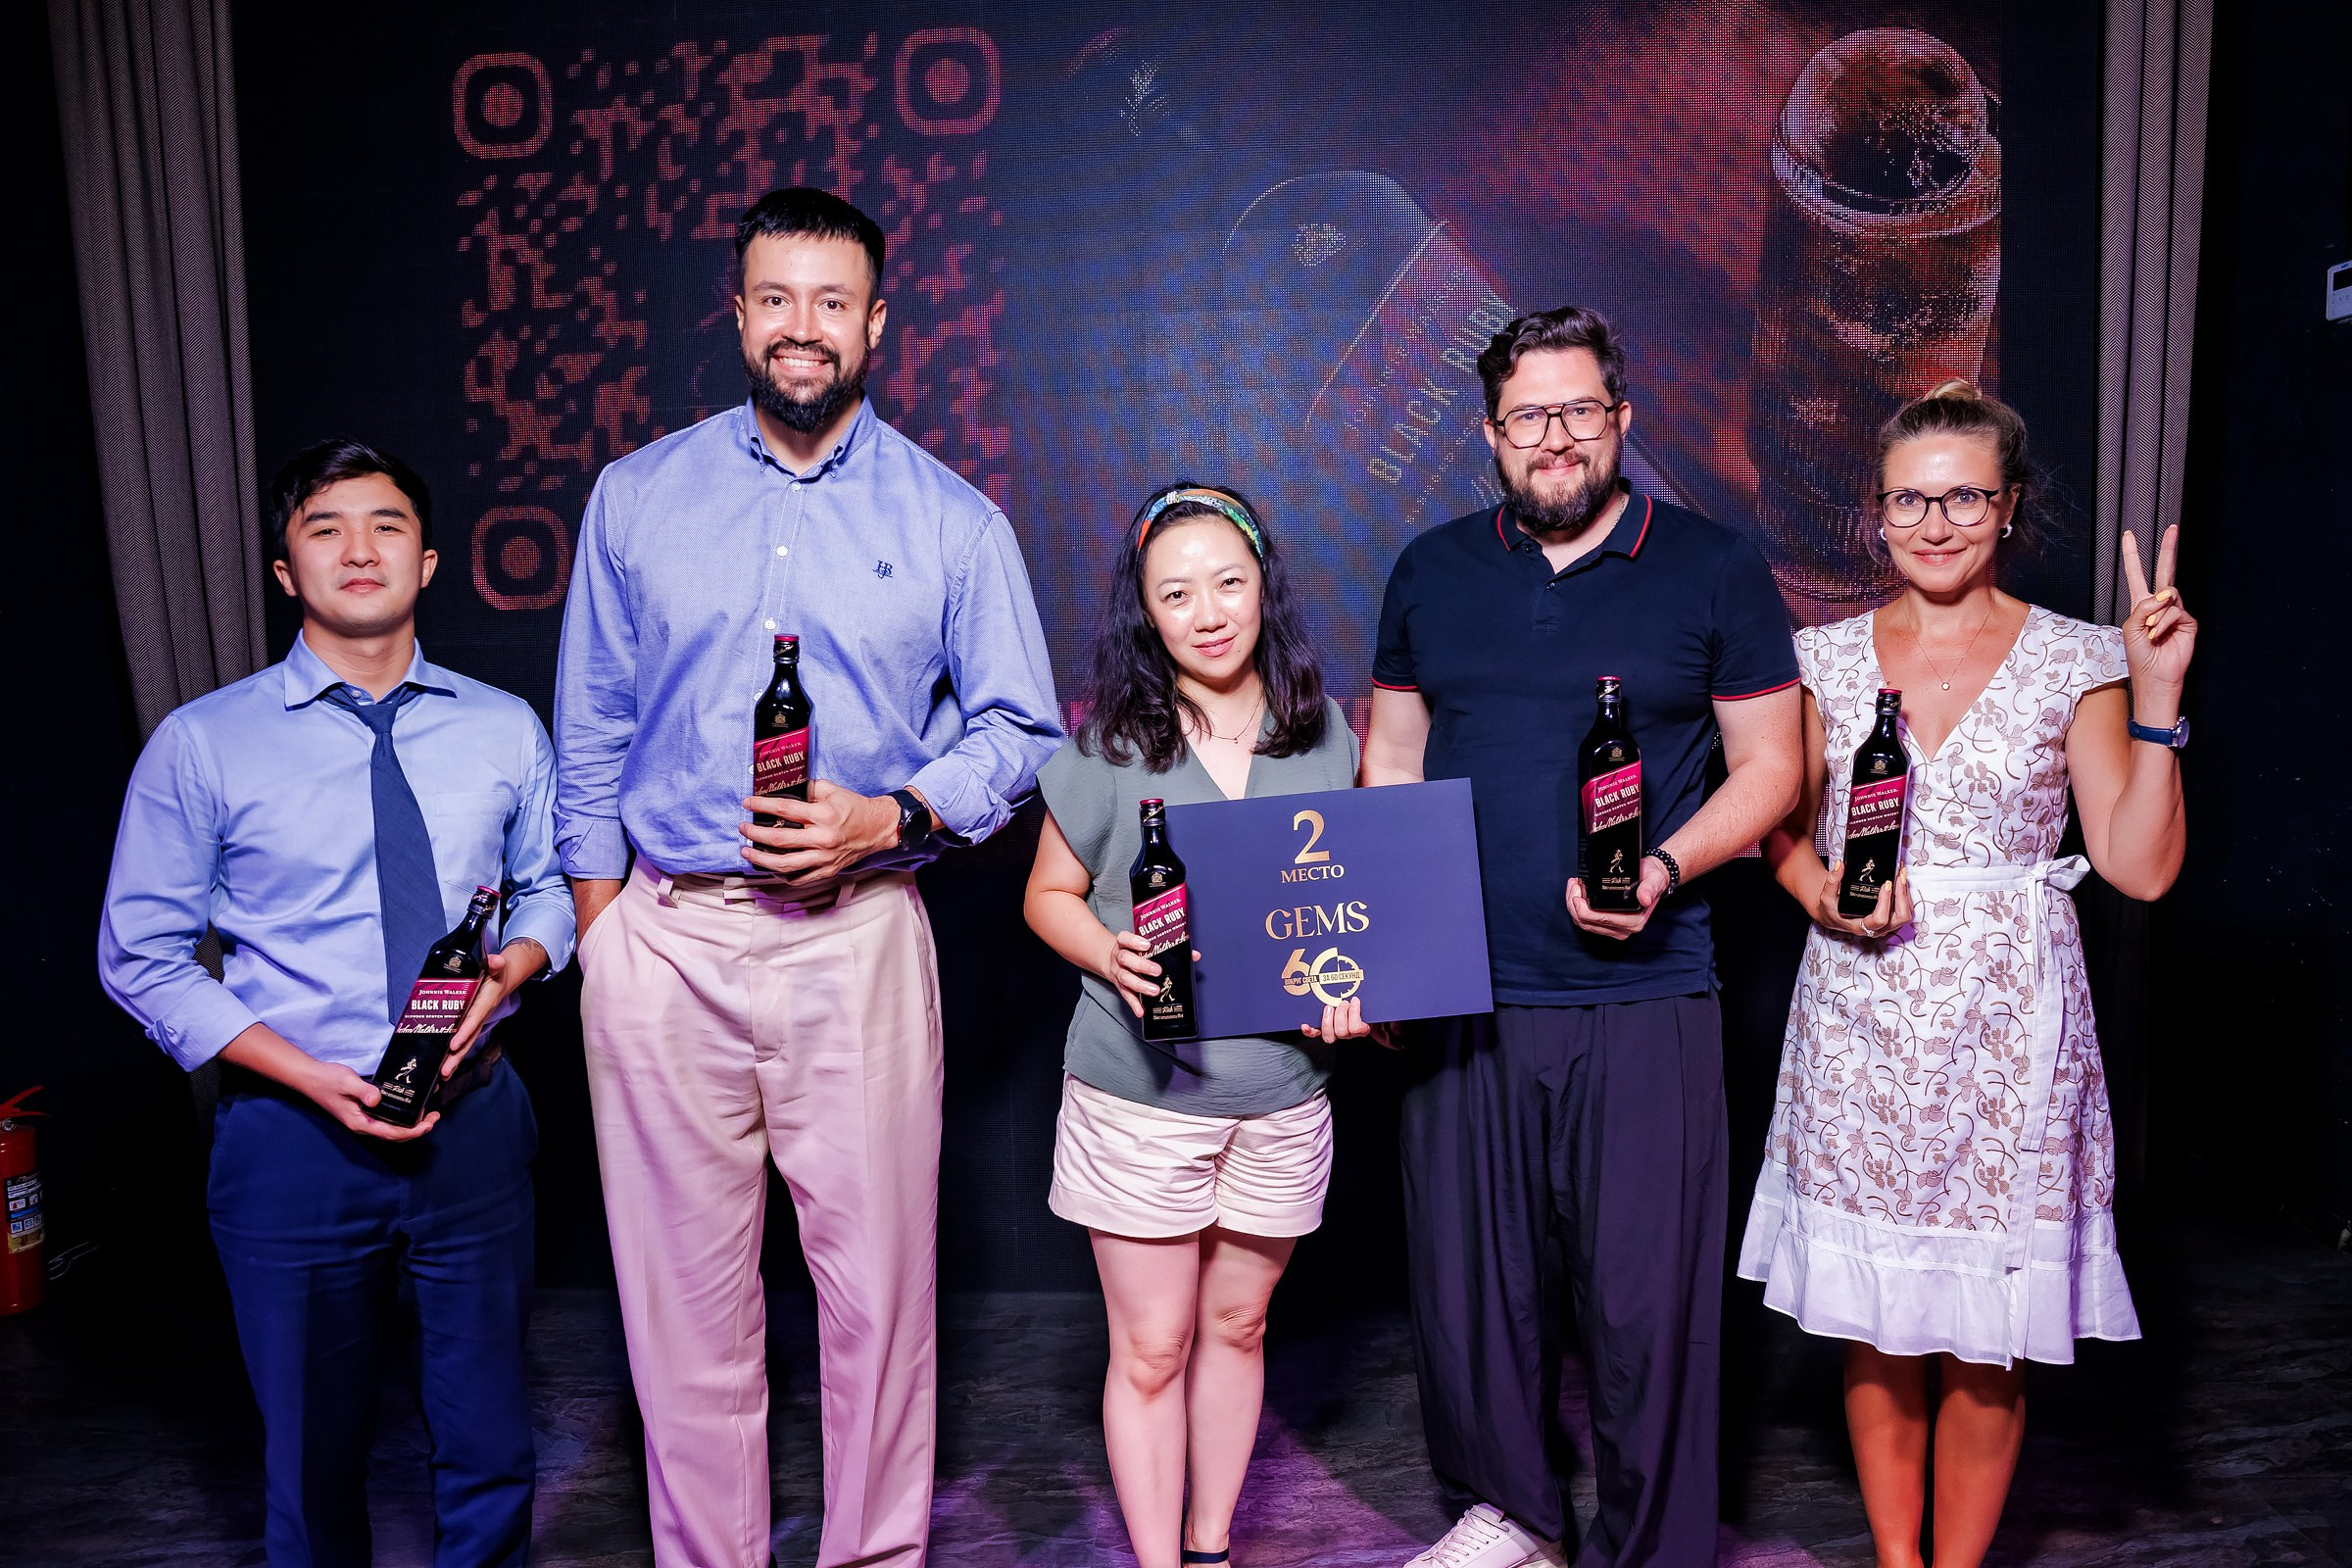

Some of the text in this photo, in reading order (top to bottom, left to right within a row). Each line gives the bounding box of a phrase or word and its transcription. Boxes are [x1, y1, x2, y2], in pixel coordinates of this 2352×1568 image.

[1366, 377, 1458, 484] BLACK
[1440, 291, 1518, 374] RUBY
[757, 751, 805, 772] BLACK RUBY
[1594, 783, 1640, 808] BLACK RUBY
[1851, 798, 1899, 816] BLACK RUBY
[1293, 809, 1330, 864] 2
[1280, 864, 1345, 884] МЕСТО
[1138, 907, 1185, 936] BLACK RUBY
[1265, 901, 1370, 940] GEMS
[1339, 971, 1361, 980] СЕКУНД
[412, 1000, 466, 1010] BLACK RUBY
